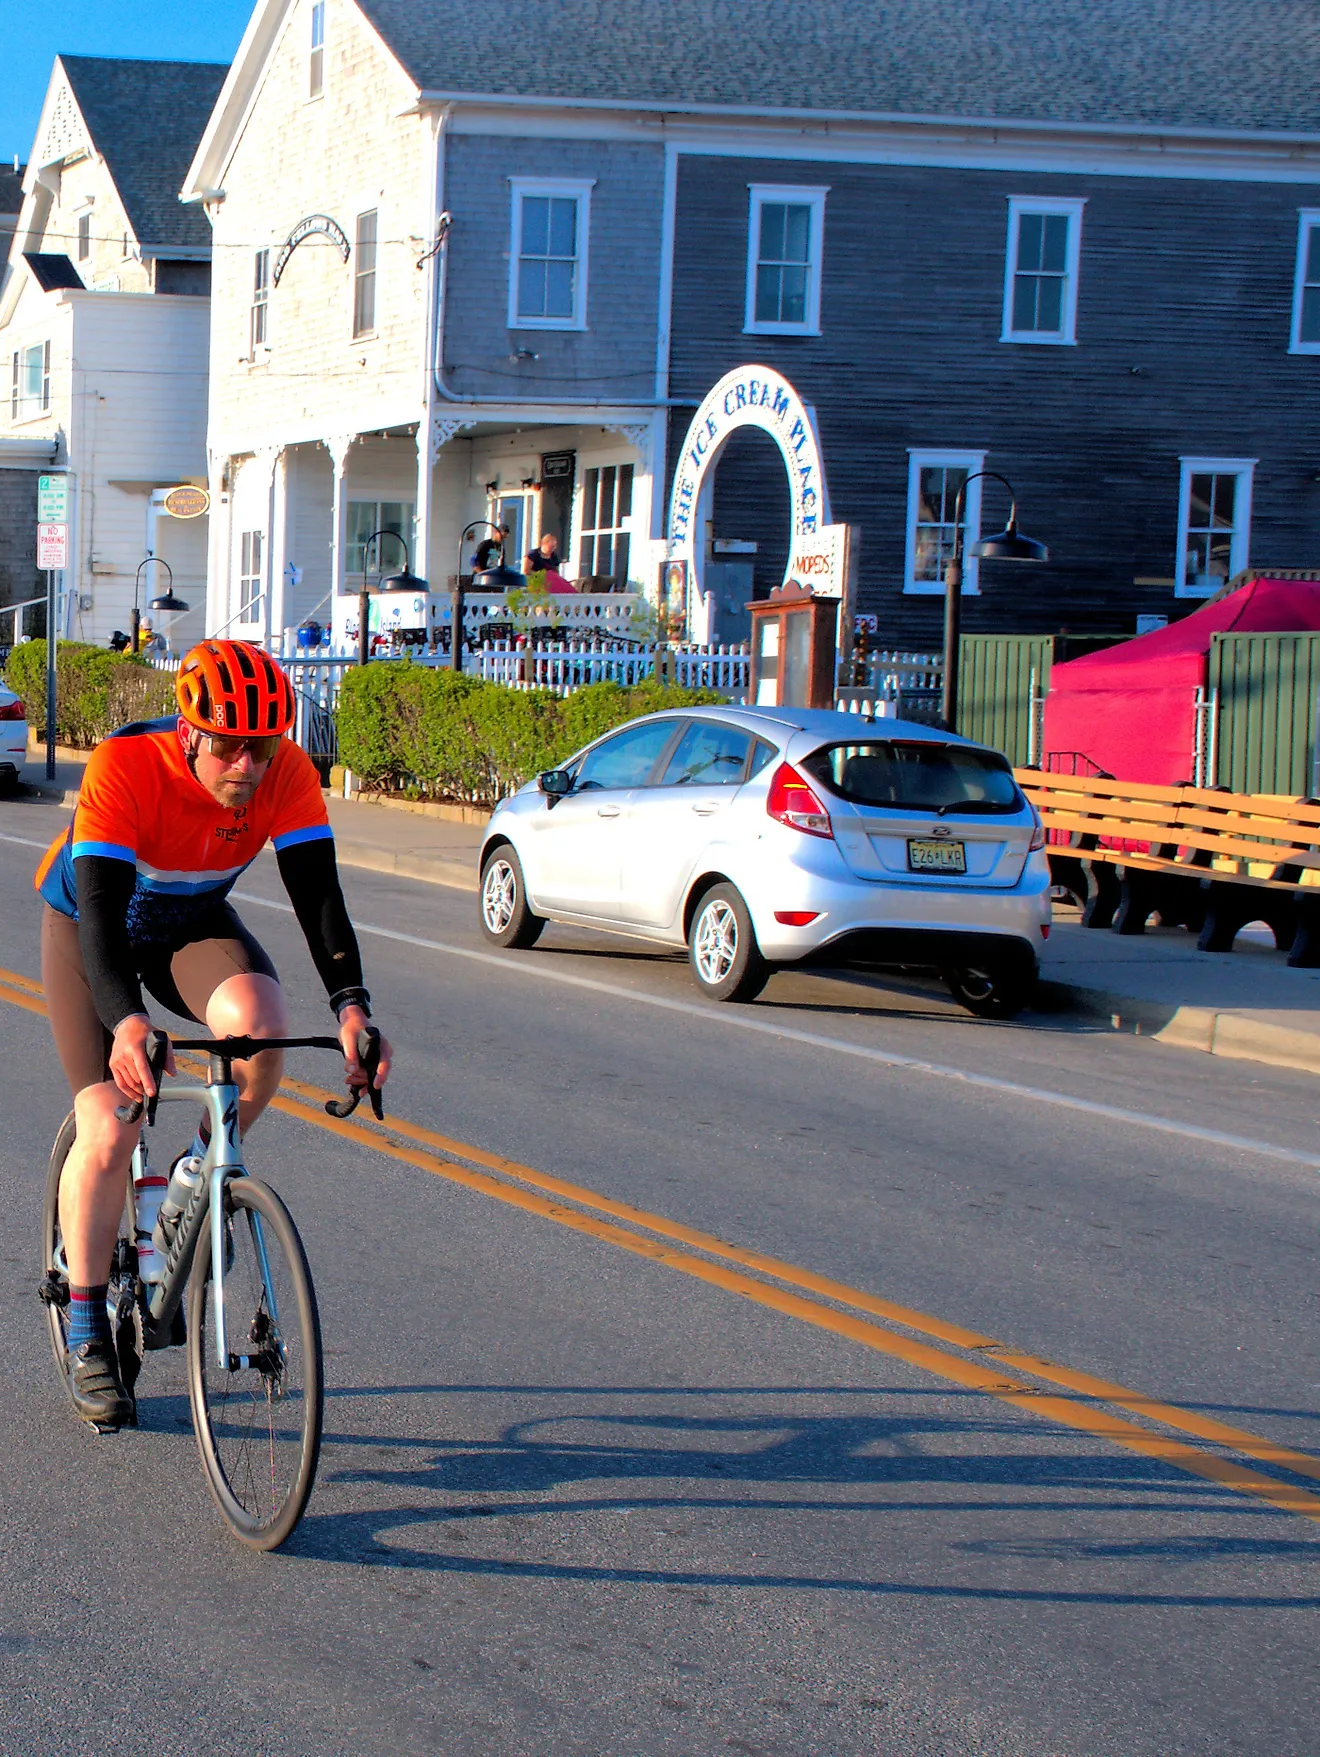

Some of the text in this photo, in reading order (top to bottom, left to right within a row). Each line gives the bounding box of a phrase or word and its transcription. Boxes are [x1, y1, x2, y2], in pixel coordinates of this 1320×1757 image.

[690, 411, 719, 470] ICE
[723, 379, 790, 422] CREAM
[790, 415, 817, 536] PLACE
[41, 477, 49, 489] 2
[47, 527, 58, 535] NO
[41, 536, 65, 544] PARKING
[796, 554, 830, 575] MOPEDS
[215, 704, 225, 728] poc
